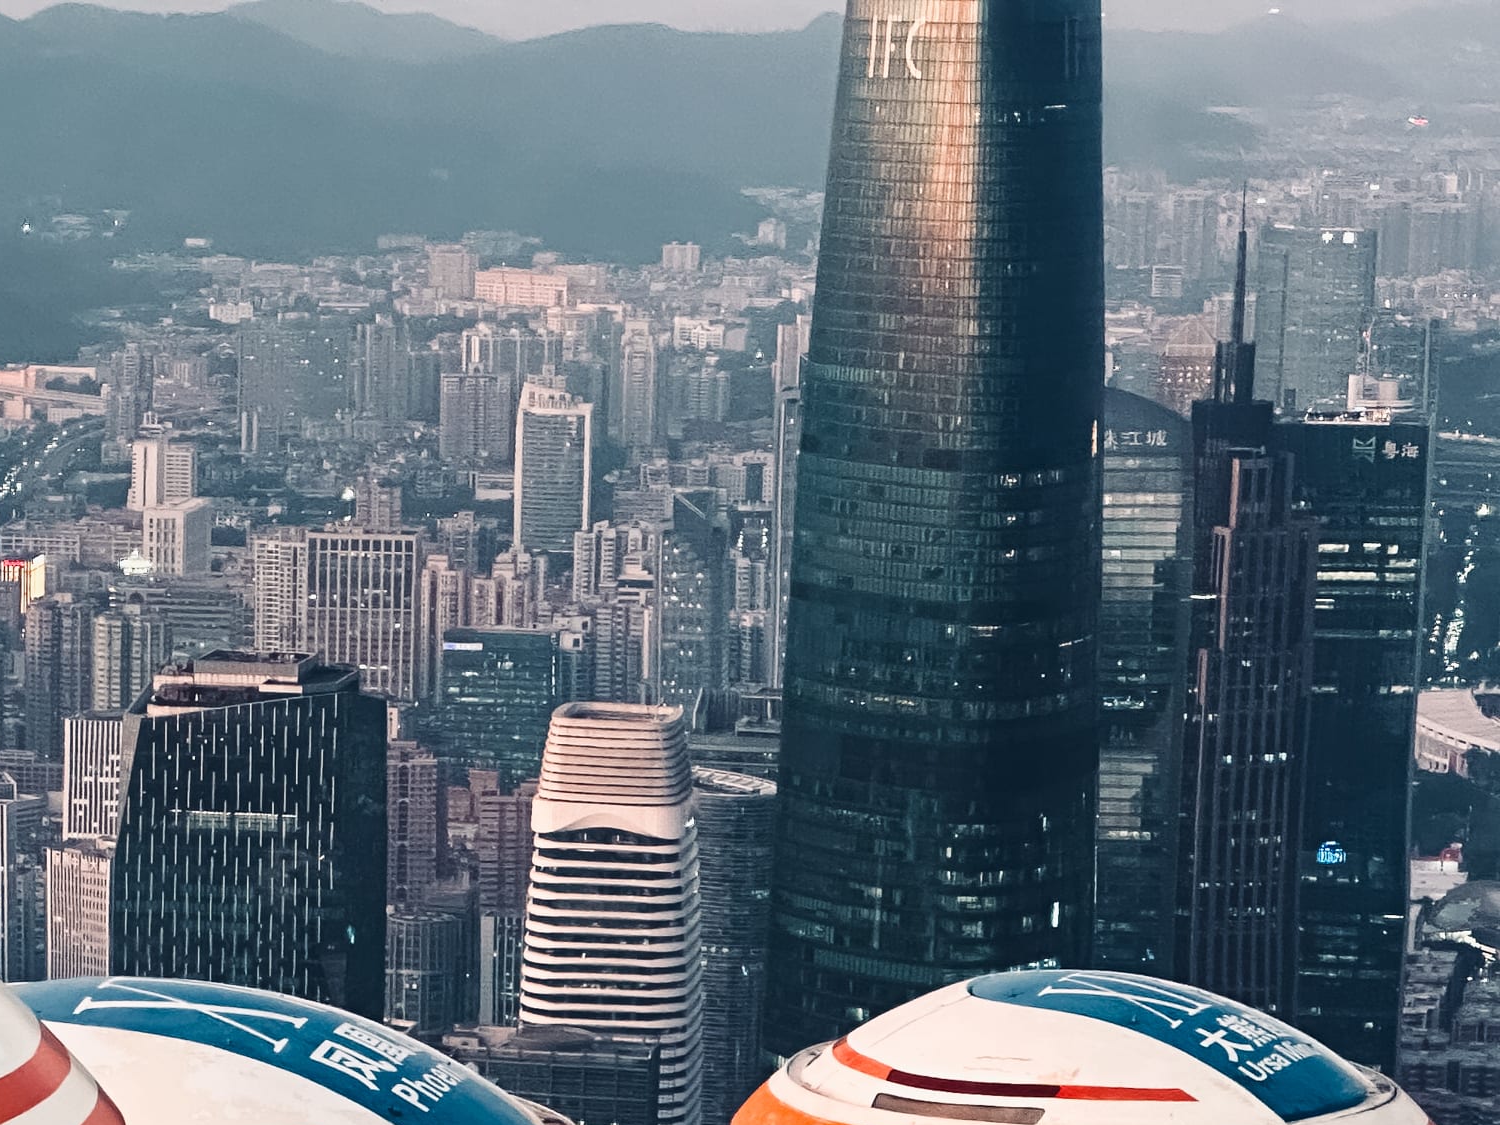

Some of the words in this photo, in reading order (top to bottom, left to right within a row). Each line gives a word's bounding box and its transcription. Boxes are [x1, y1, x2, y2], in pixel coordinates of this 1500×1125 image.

[869, 15, 925, 79] IFC
[1195, 1013, 1285, 1063] 大熊
[391, 1062, 463, 1113] Phoen
[1238, 1053, 1292, 1081] Ursa
